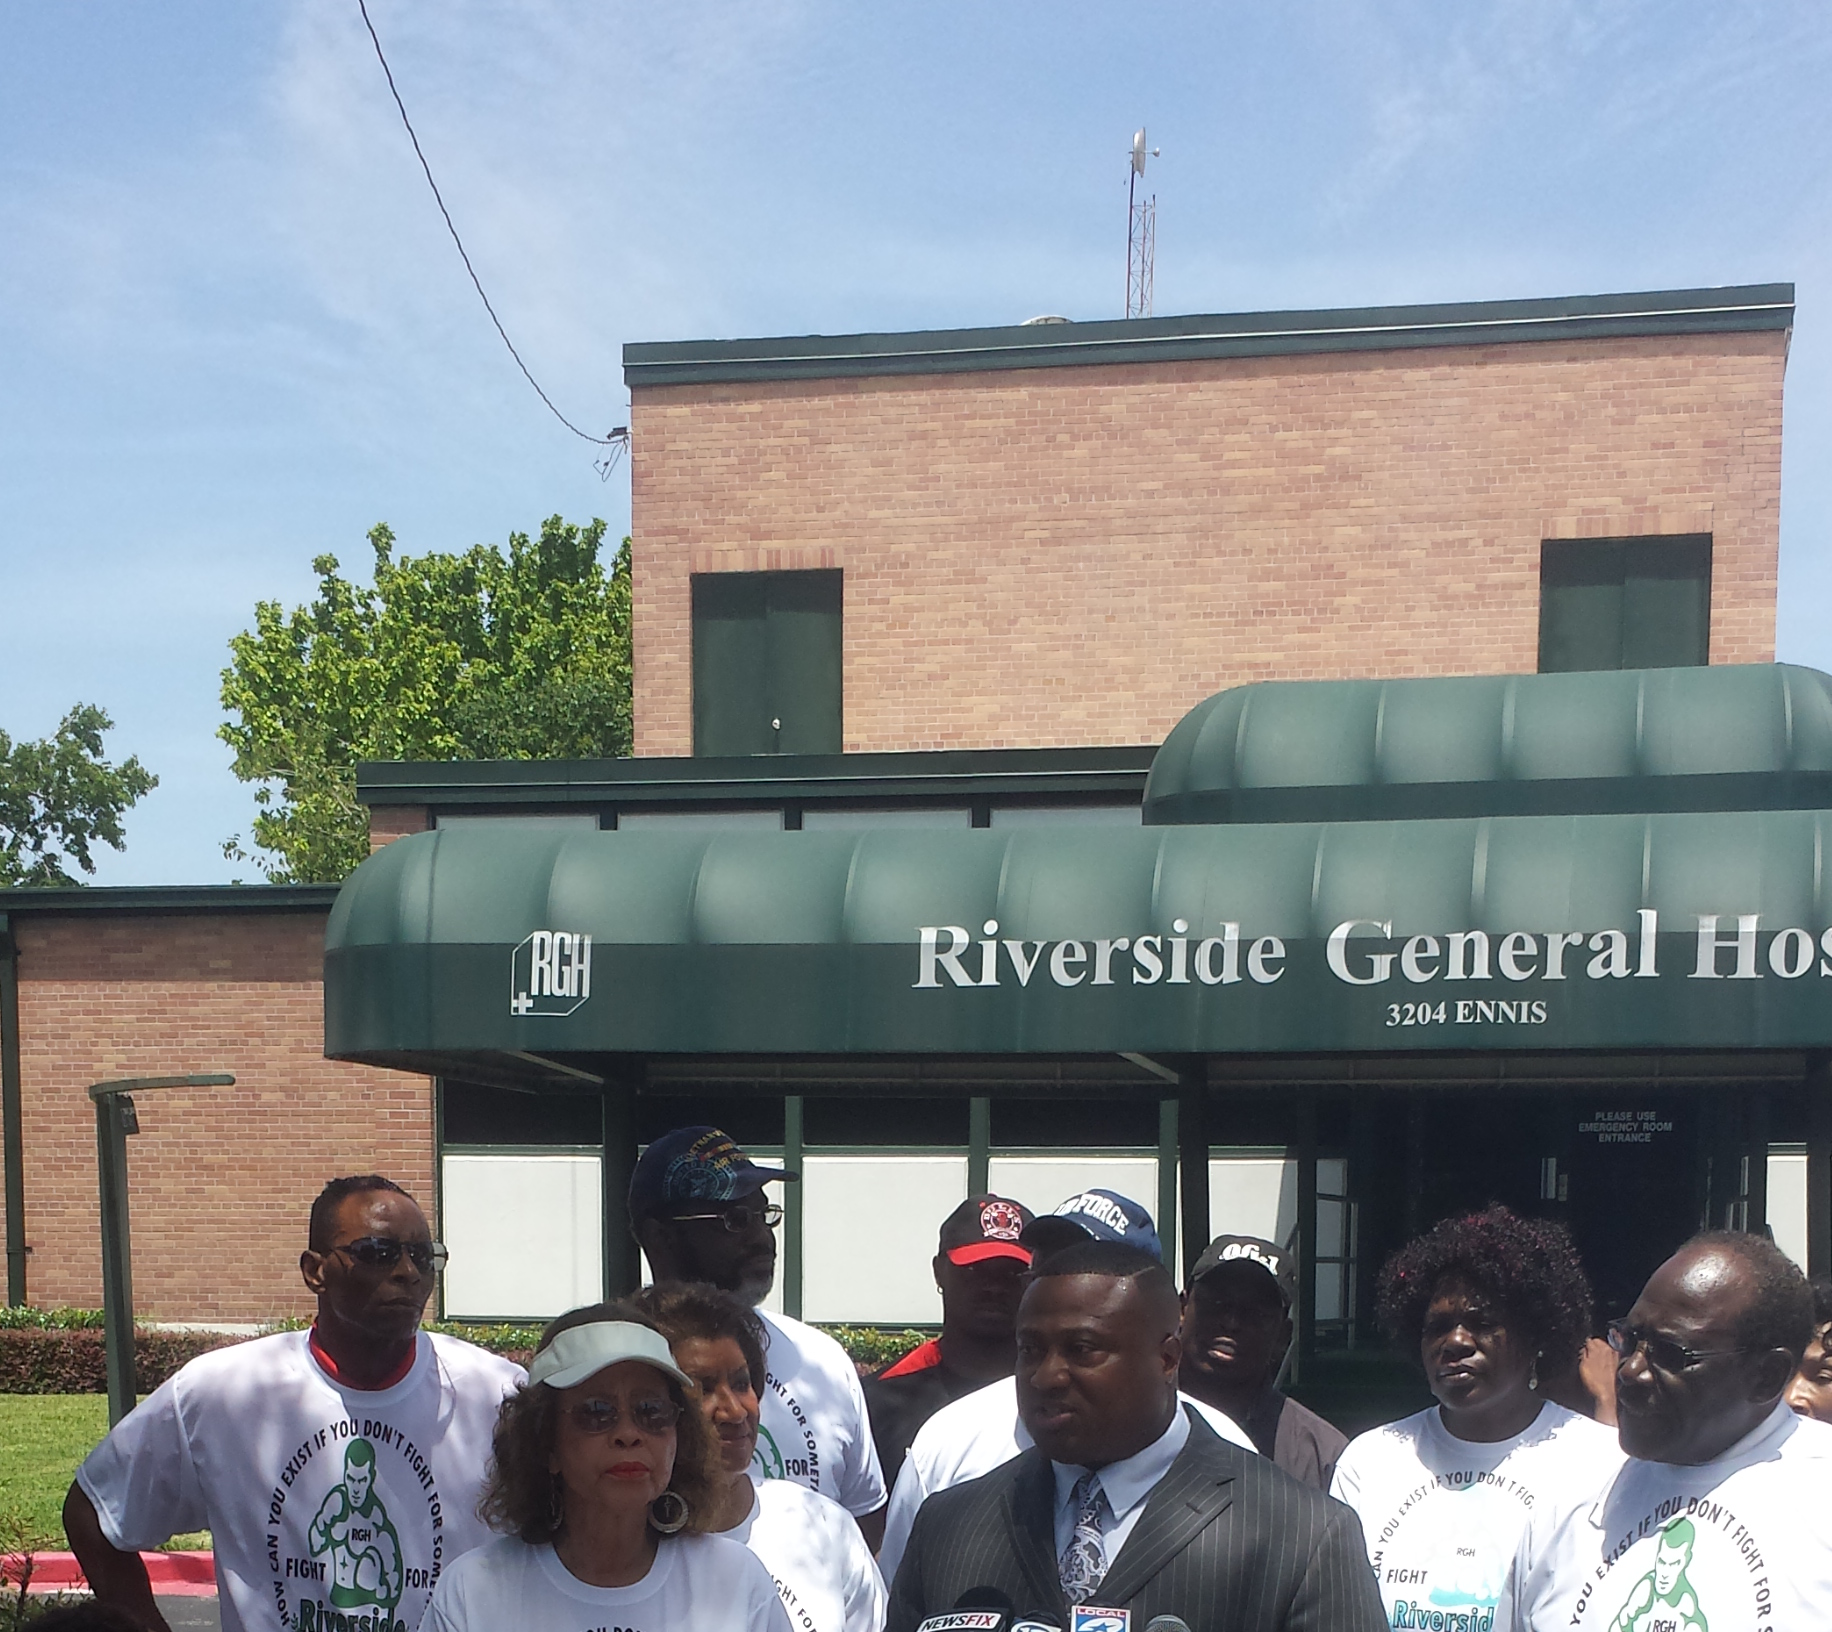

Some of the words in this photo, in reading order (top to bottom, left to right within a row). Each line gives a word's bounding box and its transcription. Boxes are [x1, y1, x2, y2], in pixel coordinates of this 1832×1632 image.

[530, 930, 593, 998] RGH
[911, 918, 1287, 989] Riverside
[1325, 908, 1660, 986] General
[1385, 1001, 1447, 1027] 3204
[1454, 1000, 1548, 1025] ENNIS
[1578, 1122, 1639, 1132] EMERGENCY
[1642, 1121, 1673, 1132] ROOM
[1595, 1111, 1633, 1121] PLEASE
[1636, 1111, 1657, 1121] USE
[1598, 1132, 1652, 1143] ENTRANCE
[1080, 1193, 1130, 1236] FORCE
[765, 1372, 788, 1398] GHT
[787, 1397, 807, 1427] FOR
[313, 1428, 327, 1451] IF
[330, 1418, 359, 1441] YOU
[363, 1419, 405, 1451] DON'T
[281, 1440, 313, 1489] EXIST
[403, 1442, 435, 1491] FIGHT
[784, 1459, 809, 1477] FOR
[268, 1486, 286, 1526] YOU
[427, 1491, 443, 1531] FOR
[1378, 1517, 1400, 1545] YOU
[1398, 1485, 1429, 1516] EXIST
[1430, 1475, 1442, 1491] IF
[1445, 1471, 1473, 1485] YOU
[1515, 1485, 1535, 1510] FIG
[351, 1527, 371, 1543] RGH
[267, 1534, 279, 1573] CAN
[1456, 1547, 1476, 1558] RGH
[1569, 1581, 1593, 1627] YOU
[1596, 1531, 1634, 1580] EXIST
[1637, 1518, 1652, 1538] IF
[1653, 1496, 1684, 1524] YOU
[1686, 1496, 1736, 1532] DON'T
[1731, 1525, 1766, 1575] FIGHT
[1752, 1576, 1773, 1619] FOR
[286, 1558, 326, 1582] FIGHT
[405, 1568, 429, 1589] FOR
[1385, 1568, 1429, 1585] FIGHT
[273, 1581, 290, 1627] HOW
[770, 1574, 798, 1606] GHT
[921, 1614, 995, 1632] NEWSFIX
[1076, 1608, 1127, 1617] LOCAL
